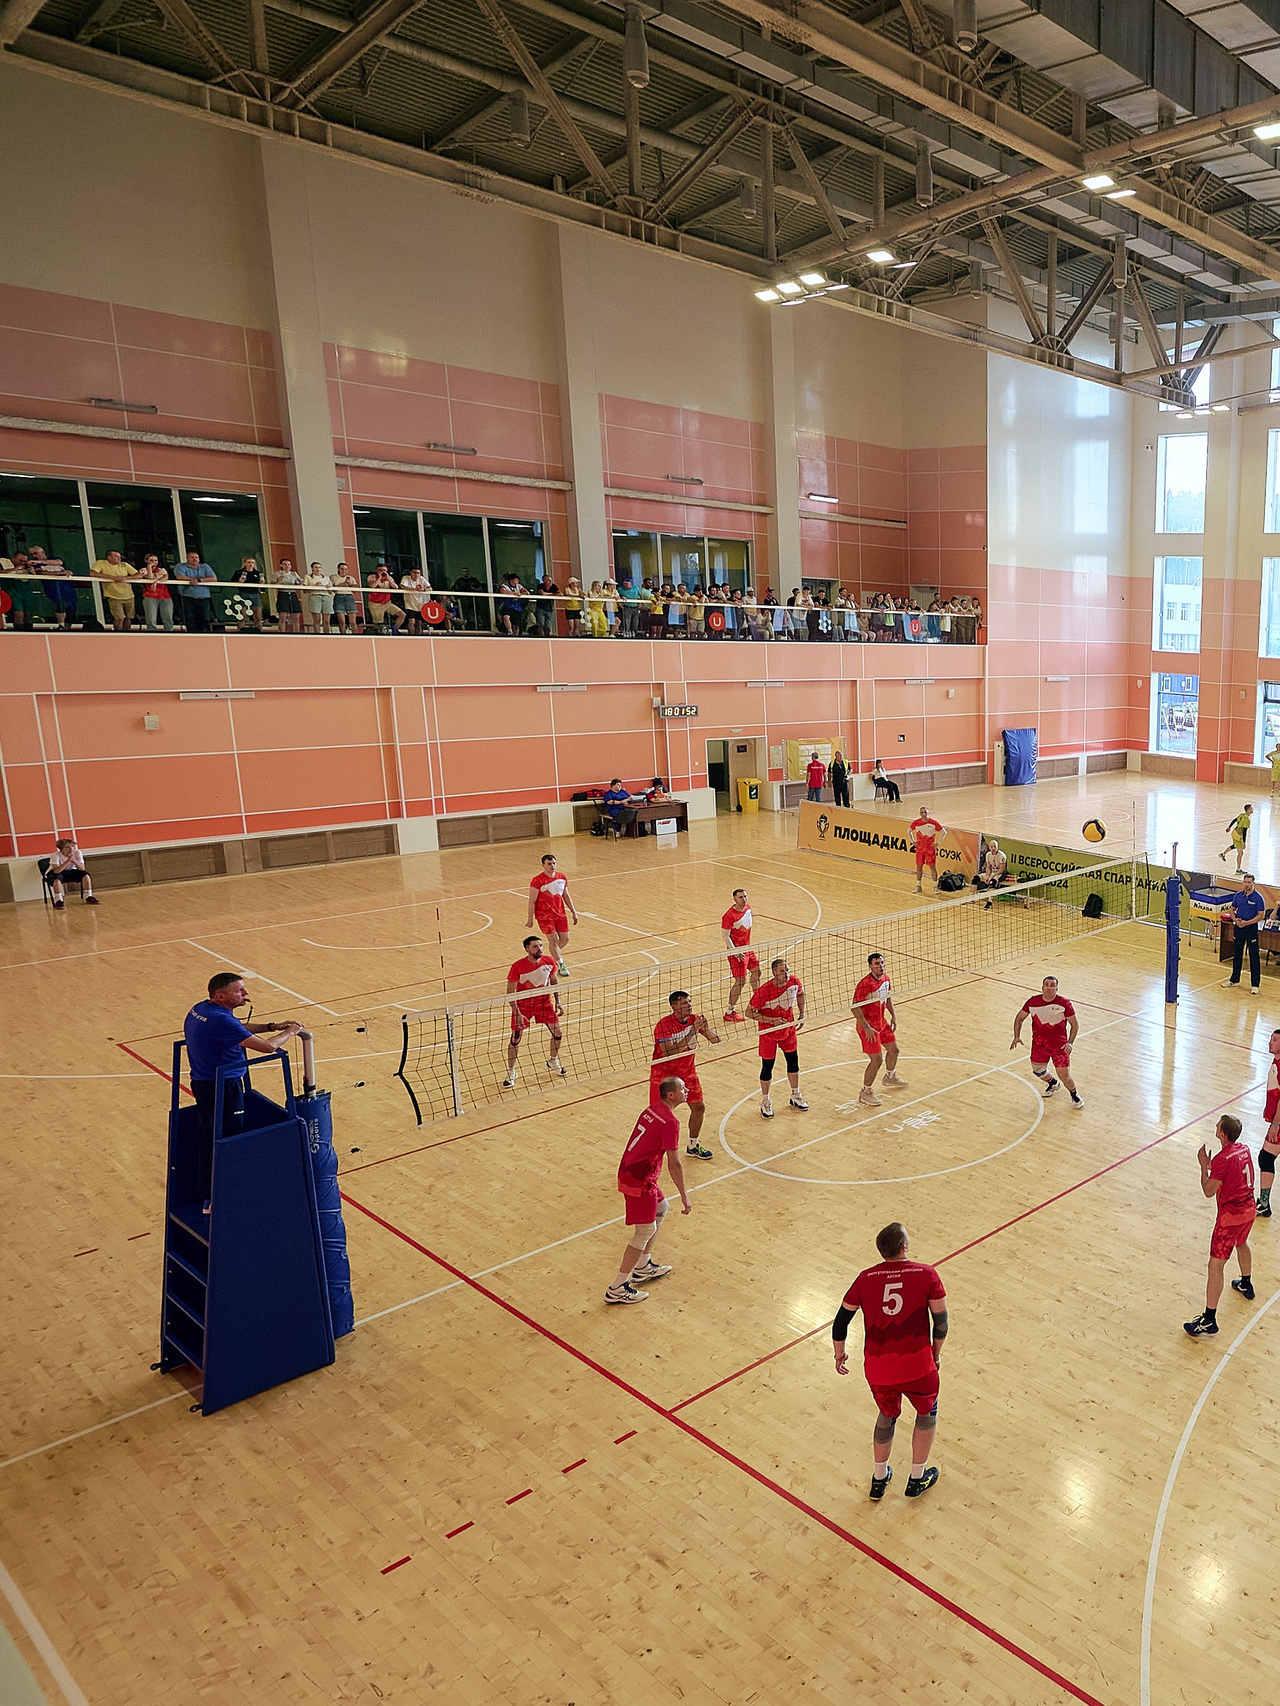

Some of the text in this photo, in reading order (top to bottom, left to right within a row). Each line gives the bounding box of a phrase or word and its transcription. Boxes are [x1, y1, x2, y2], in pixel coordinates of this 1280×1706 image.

[833, 824, 908, 852] ПЛОЩАДКА
[939, 848, 962, 862] СУЭК
[628, 1124, 646, 1152] 7
[1242, 1163, 1252, 1187] 1
[882, 1282, 904, 1316] 5
